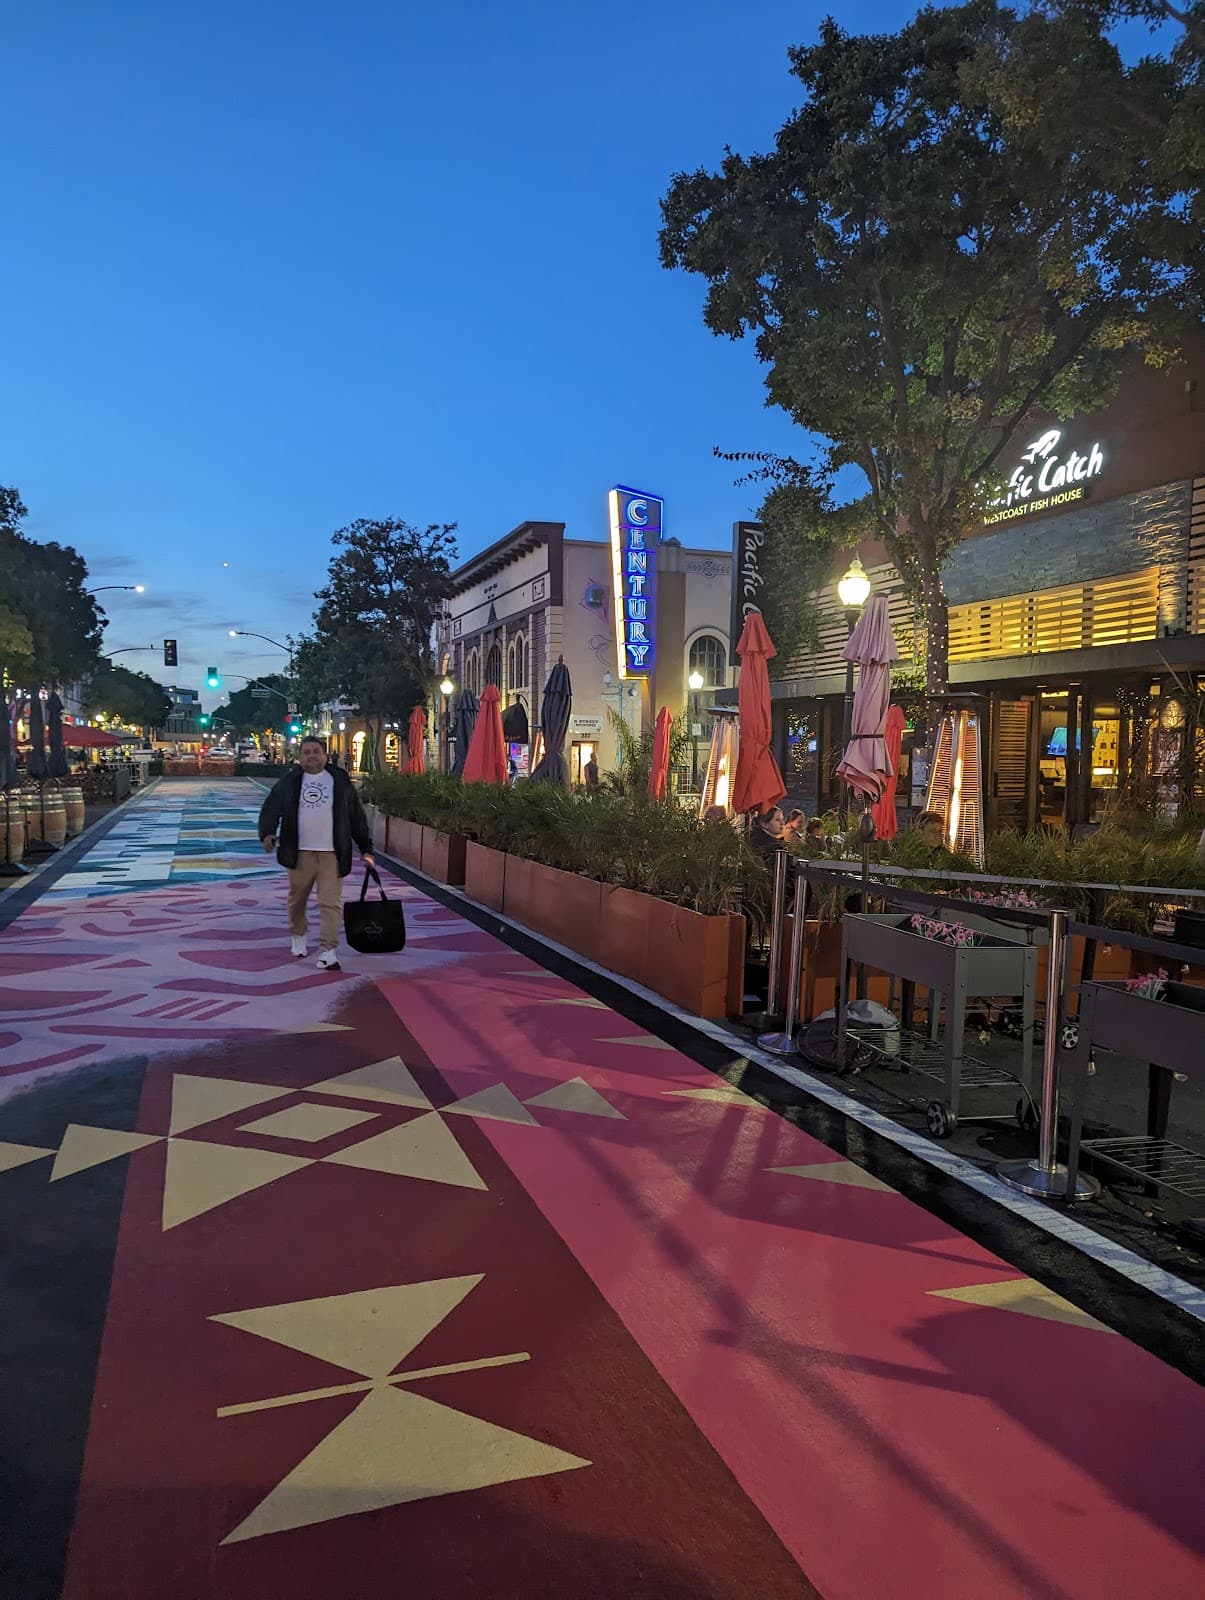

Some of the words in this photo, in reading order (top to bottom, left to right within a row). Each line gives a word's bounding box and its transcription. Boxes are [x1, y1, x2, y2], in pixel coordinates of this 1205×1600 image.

[1039, 442, 1103, 492] Catch
[1030, 497, 1049, 512] FISH
[1051, 488, 1082, 506] HOUSE
[627, 499, 649, 666] CENTURY
[741, 528, 765, 597] Pacific
